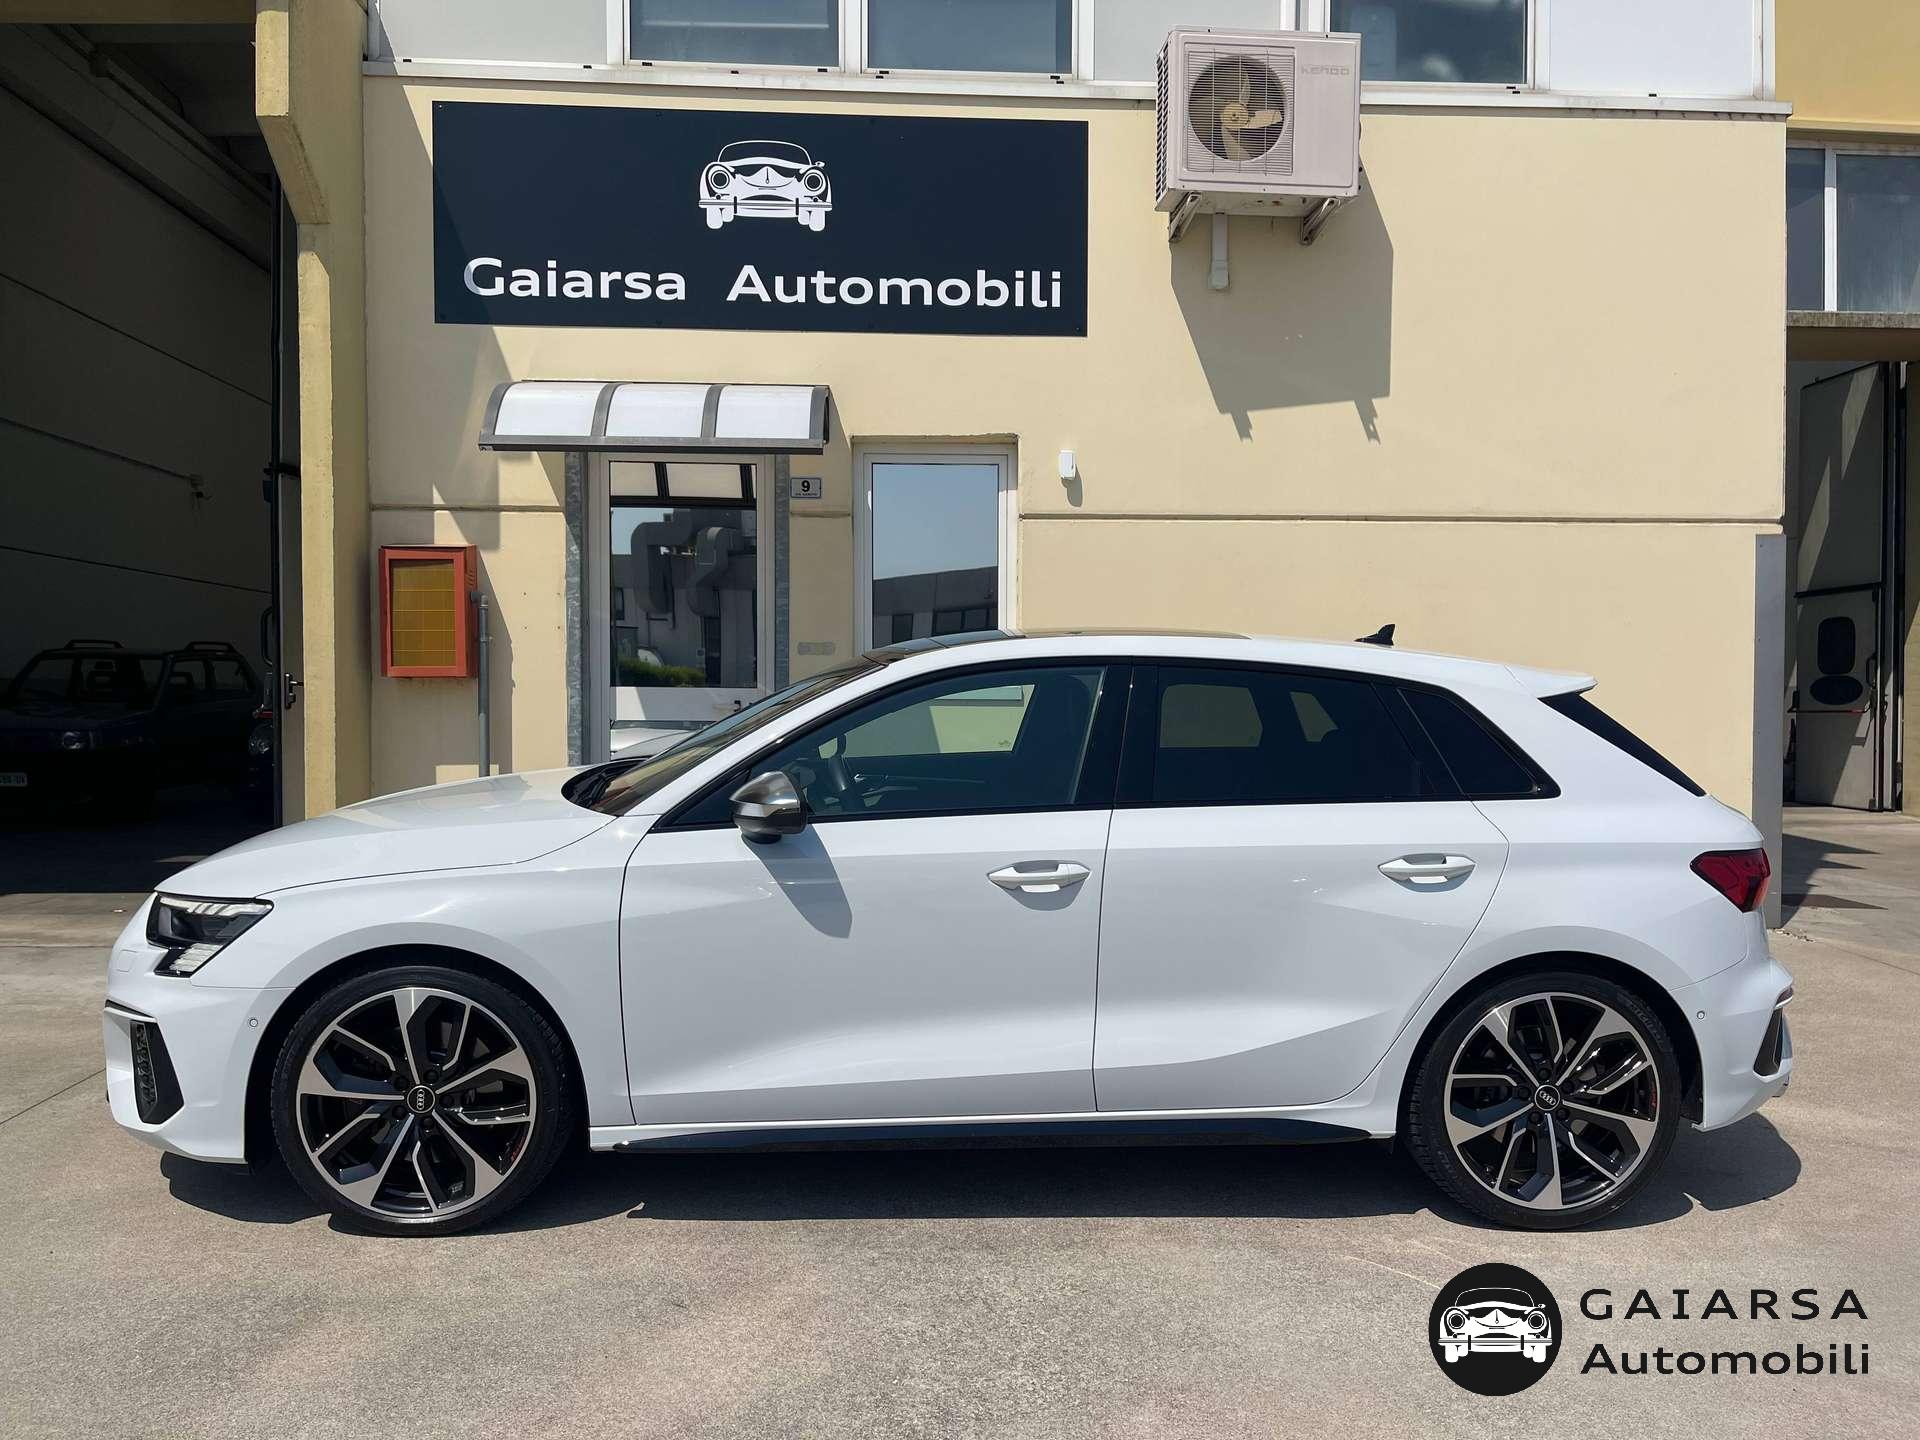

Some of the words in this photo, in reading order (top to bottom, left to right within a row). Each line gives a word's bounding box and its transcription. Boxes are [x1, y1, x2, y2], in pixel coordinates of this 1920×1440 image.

[464, 257, 686, 301] Gaiarsa
[726, 264, 1061, 308] Automobili
[801, 480, 810, 492] 9
